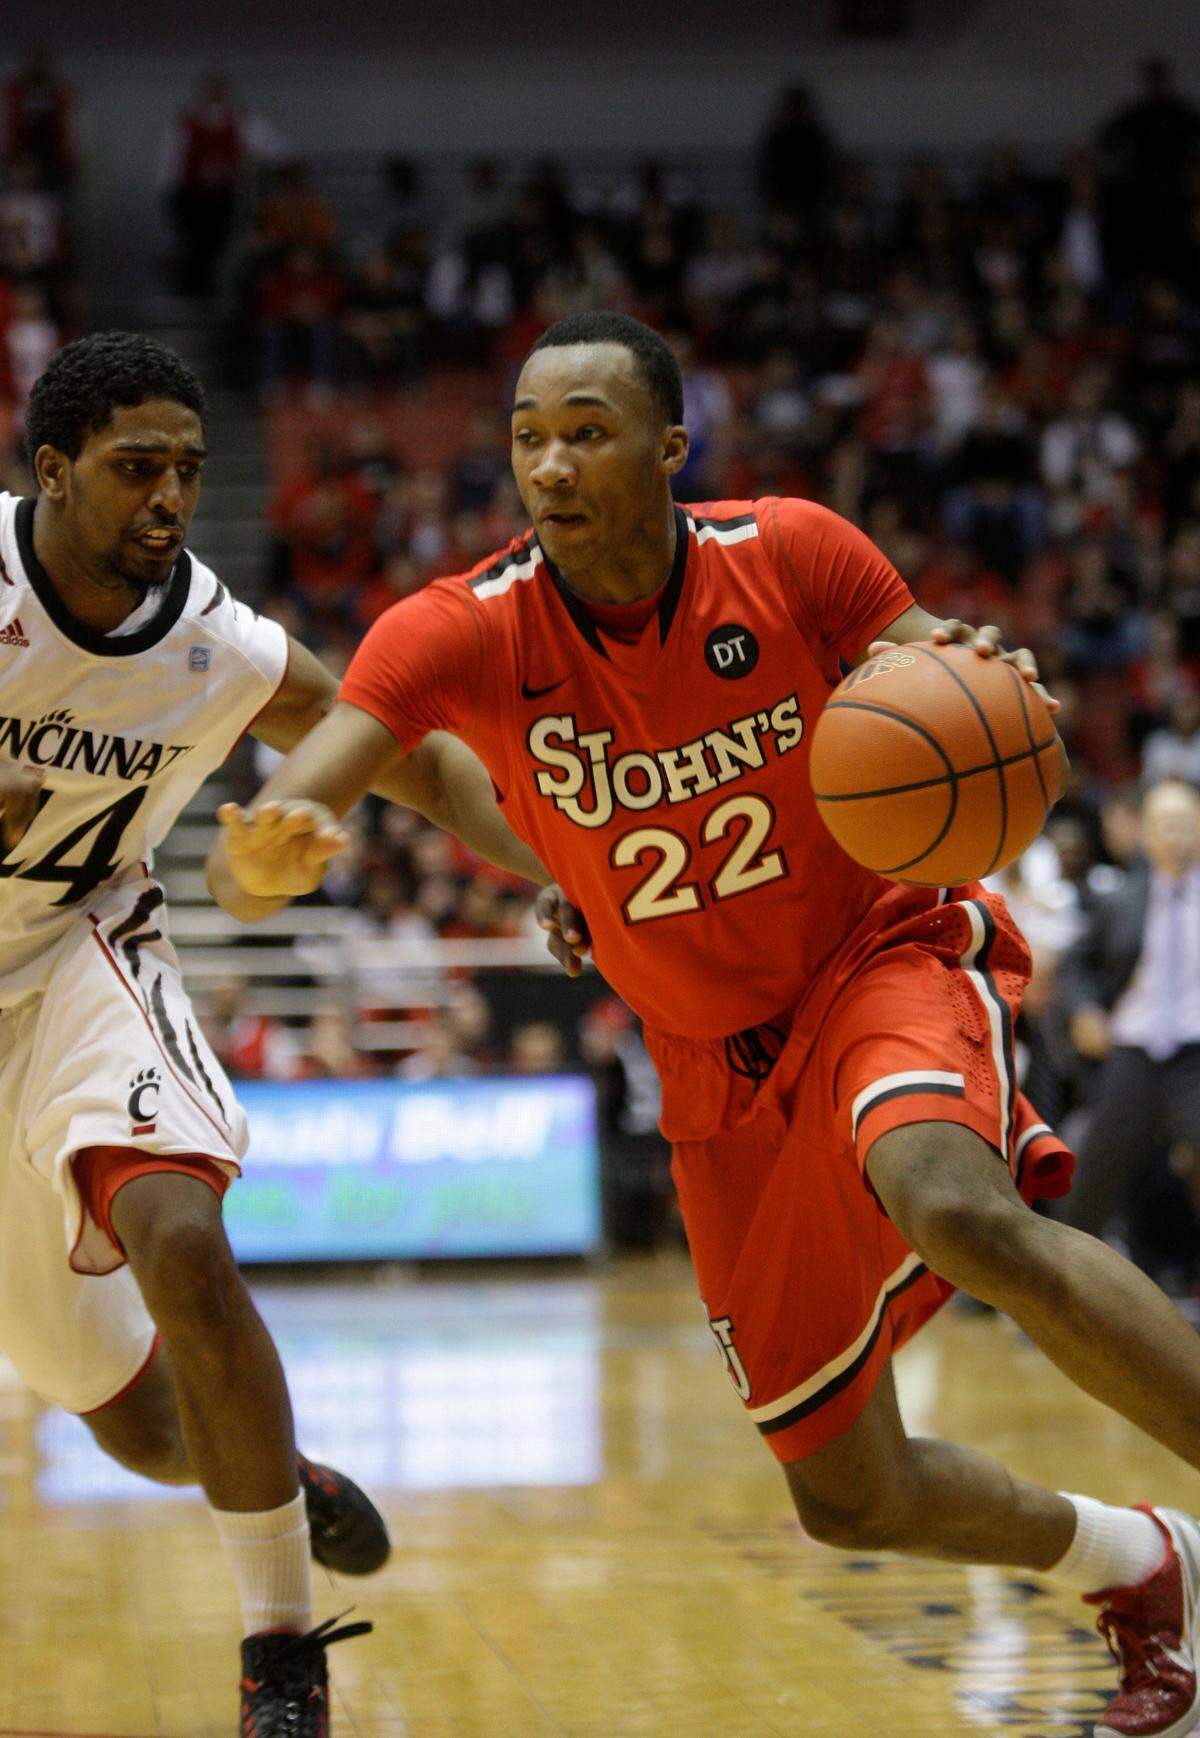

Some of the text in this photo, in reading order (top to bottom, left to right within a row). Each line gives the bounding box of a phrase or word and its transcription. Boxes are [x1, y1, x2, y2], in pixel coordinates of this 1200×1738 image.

[712, 635, 746, 669] DT
[608, 790, 789, 926] 22
[127, 1082, 160, 1123] C
